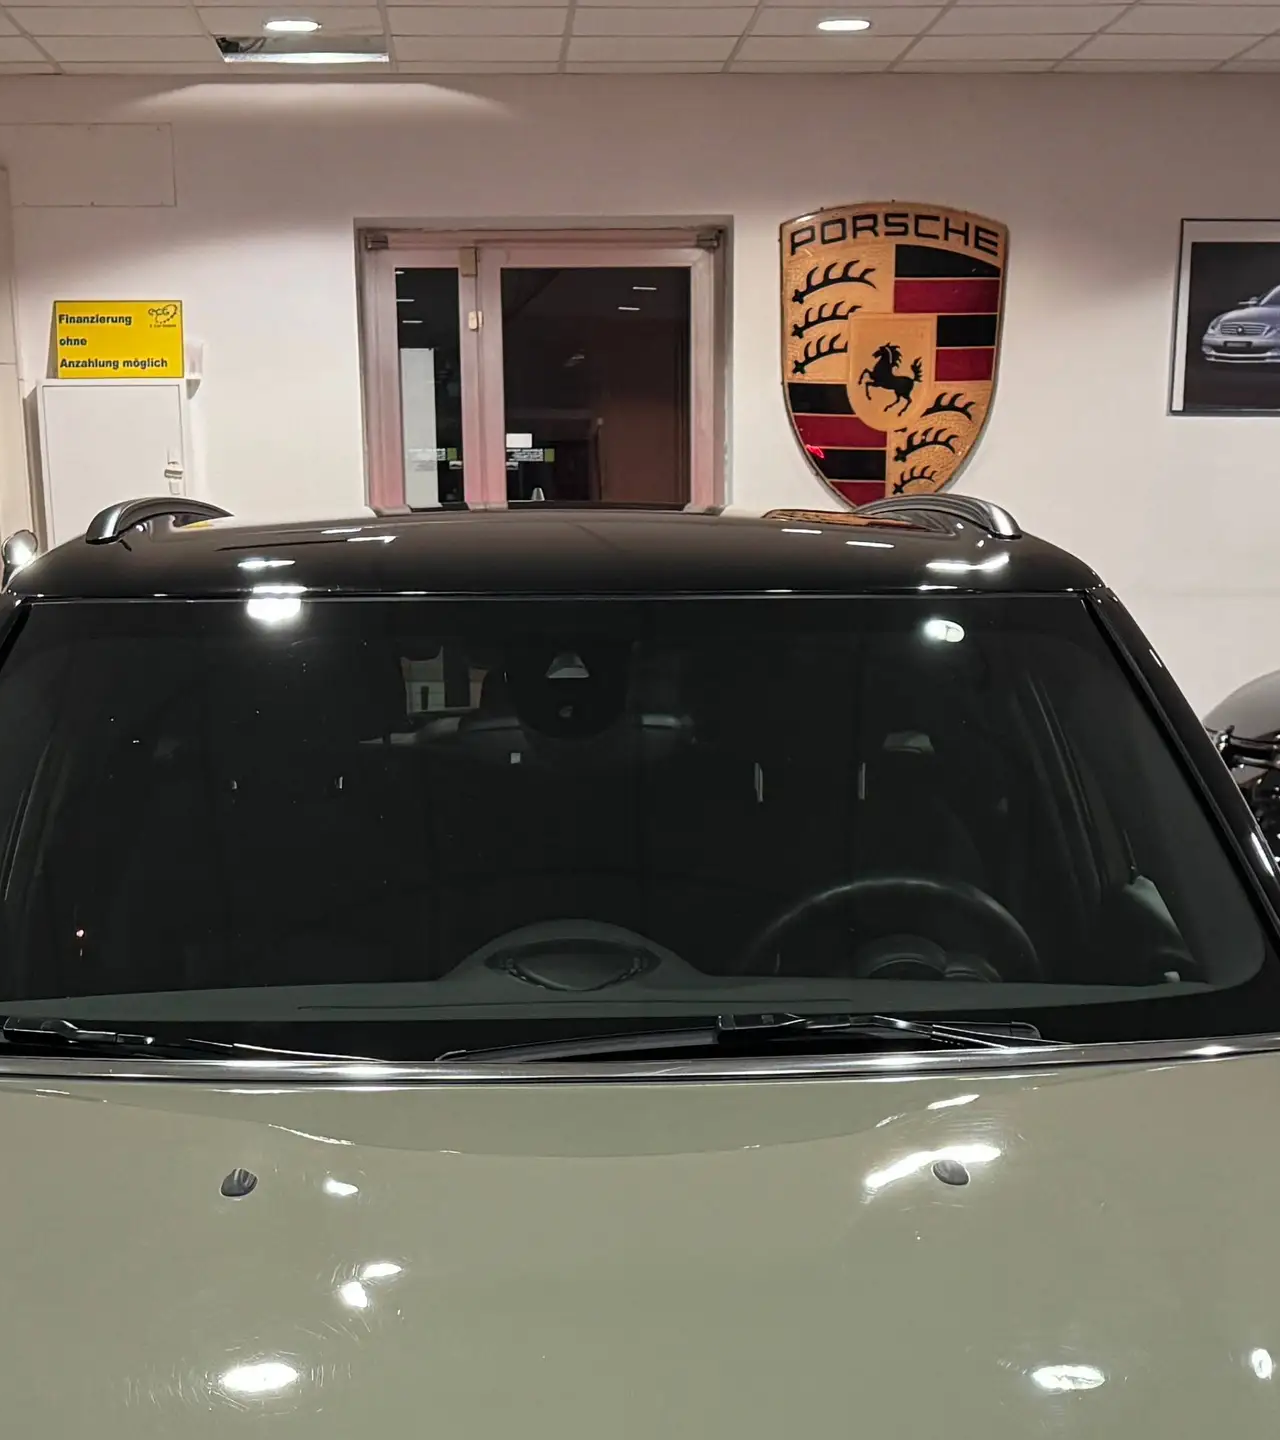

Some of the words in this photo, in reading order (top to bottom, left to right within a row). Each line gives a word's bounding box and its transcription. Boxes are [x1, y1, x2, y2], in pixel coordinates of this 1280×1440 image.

[790, 213, 999, 256] PORSCHE
[58, 314, 132, 325] Finanzierung
[59, 336, 87, 346] ohne
[60, 359, 119, 369] Anzahlung
[123, 358, 167, 369] möglich
